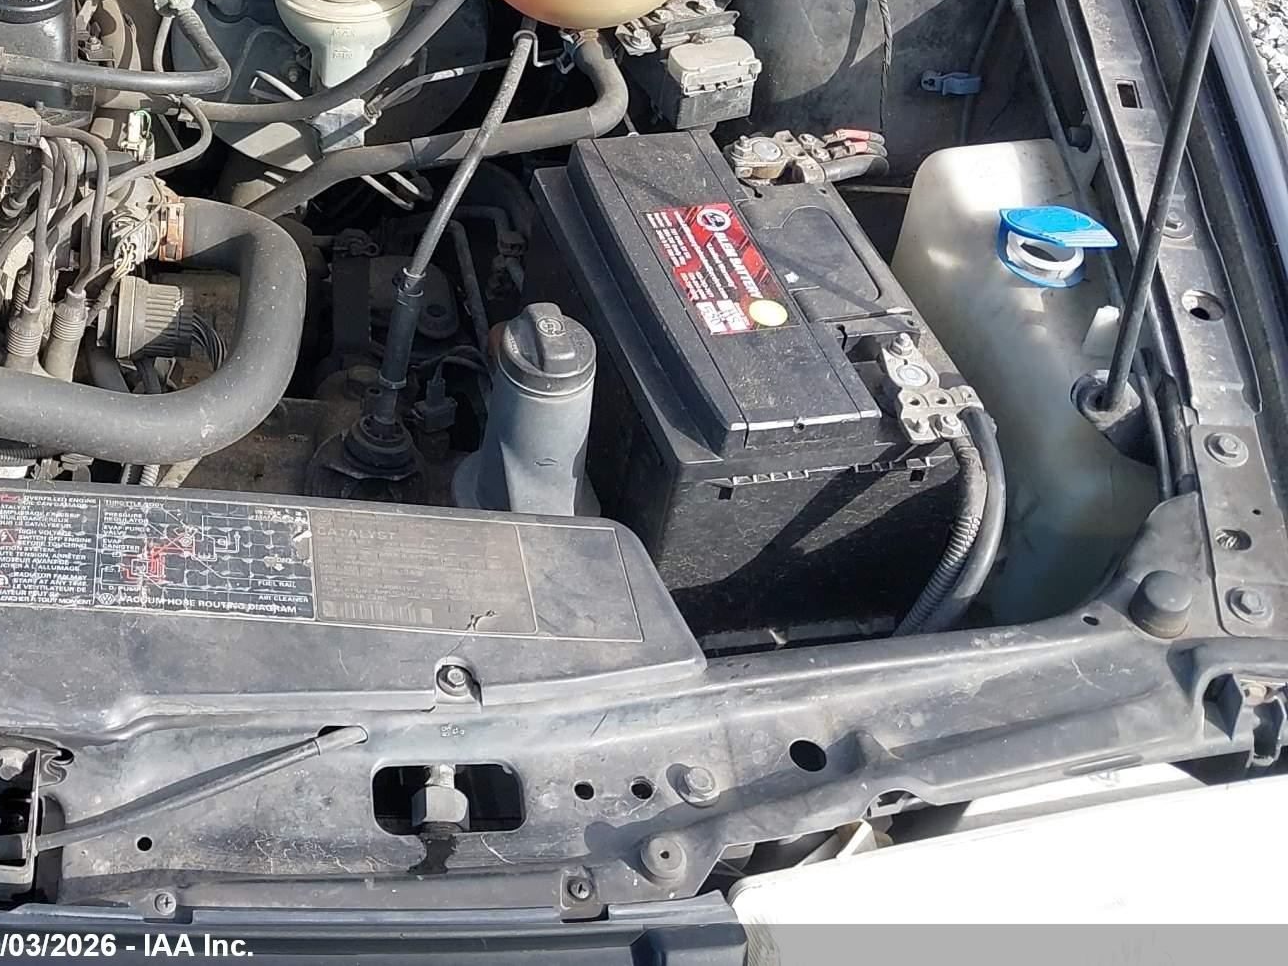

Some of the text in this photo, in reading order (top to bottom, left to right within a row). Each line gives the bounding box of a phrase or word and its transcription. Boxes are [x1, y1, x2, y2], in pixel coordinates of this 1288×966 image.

[713, 232, 738, 257] BLEM
[729, 257, 764, 299] BATTERY
[318, 527, 396, 539] CATALYST
[120, 595, 297, 613] VACUUM HOSE ROUTING DIAGRAM
